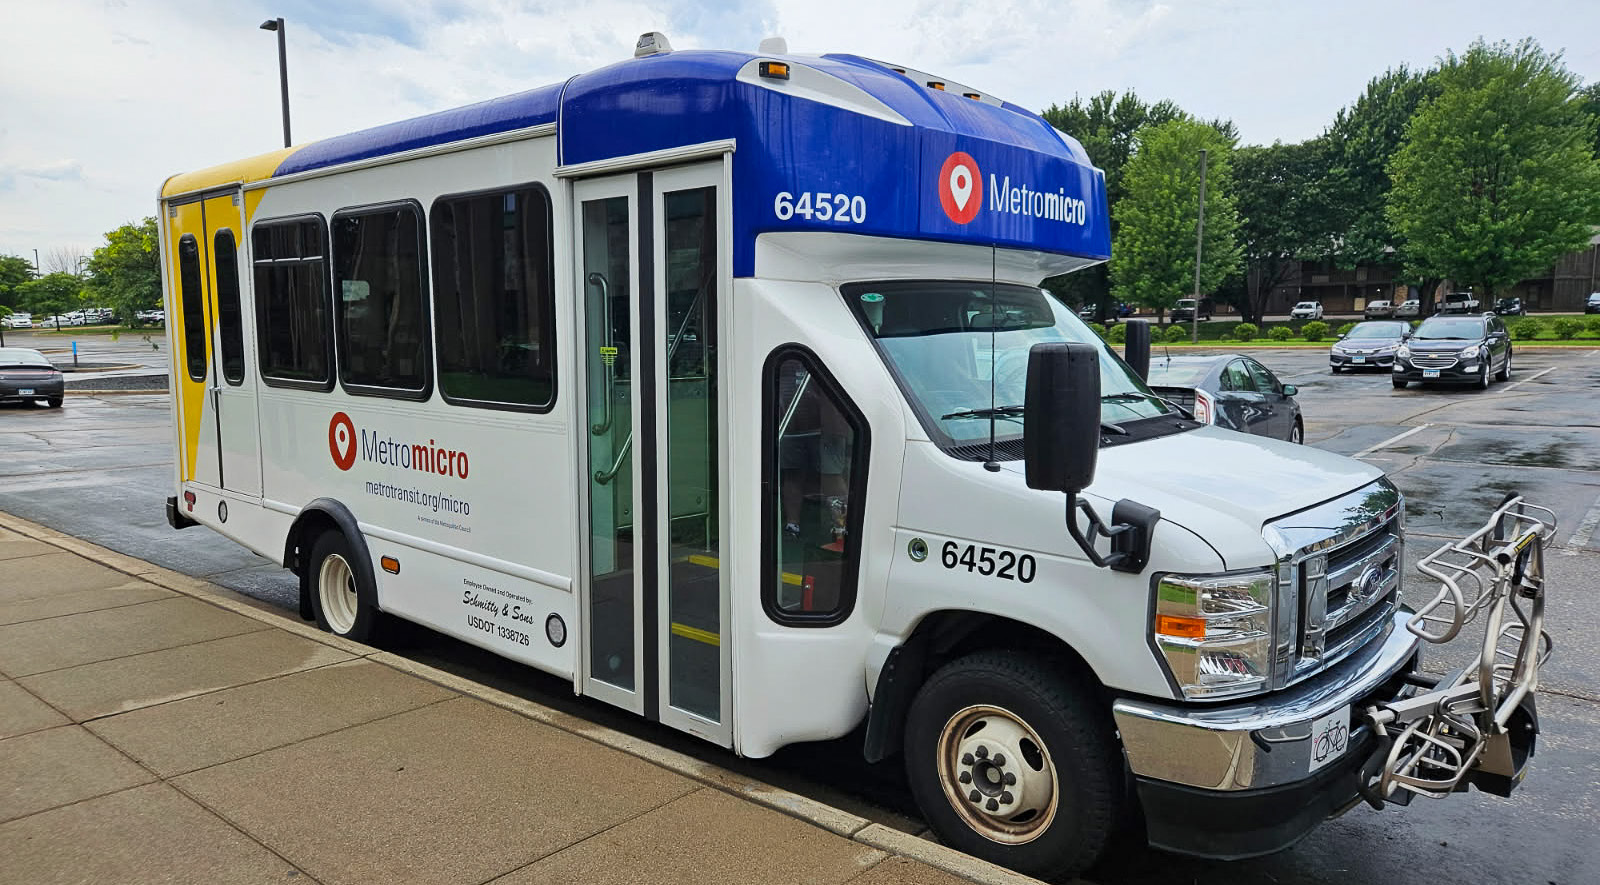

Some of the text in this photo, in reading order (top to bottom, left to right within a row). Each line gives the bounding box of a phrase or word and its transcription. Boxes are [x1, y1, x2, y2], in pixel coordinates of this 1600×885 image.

[774, 191, 867, 223] 64520
[989, 173, 1086, 226] Metromicro
[361, 428, 469, 480] Metromicro
[365, 480, 470, 516] metrotransit.org/micro
[941, 540, 1037, 584] 64520
[462, 590, 534, 625] Schmitty & Sons
[463, 578, 482, 590] Employee
[483, 584, 497, 594] Owned
[497, 589, 506, 597] and
[506, 591, 525, 602] Operated
[467, 614, 530, 647] USDOT 1338726
